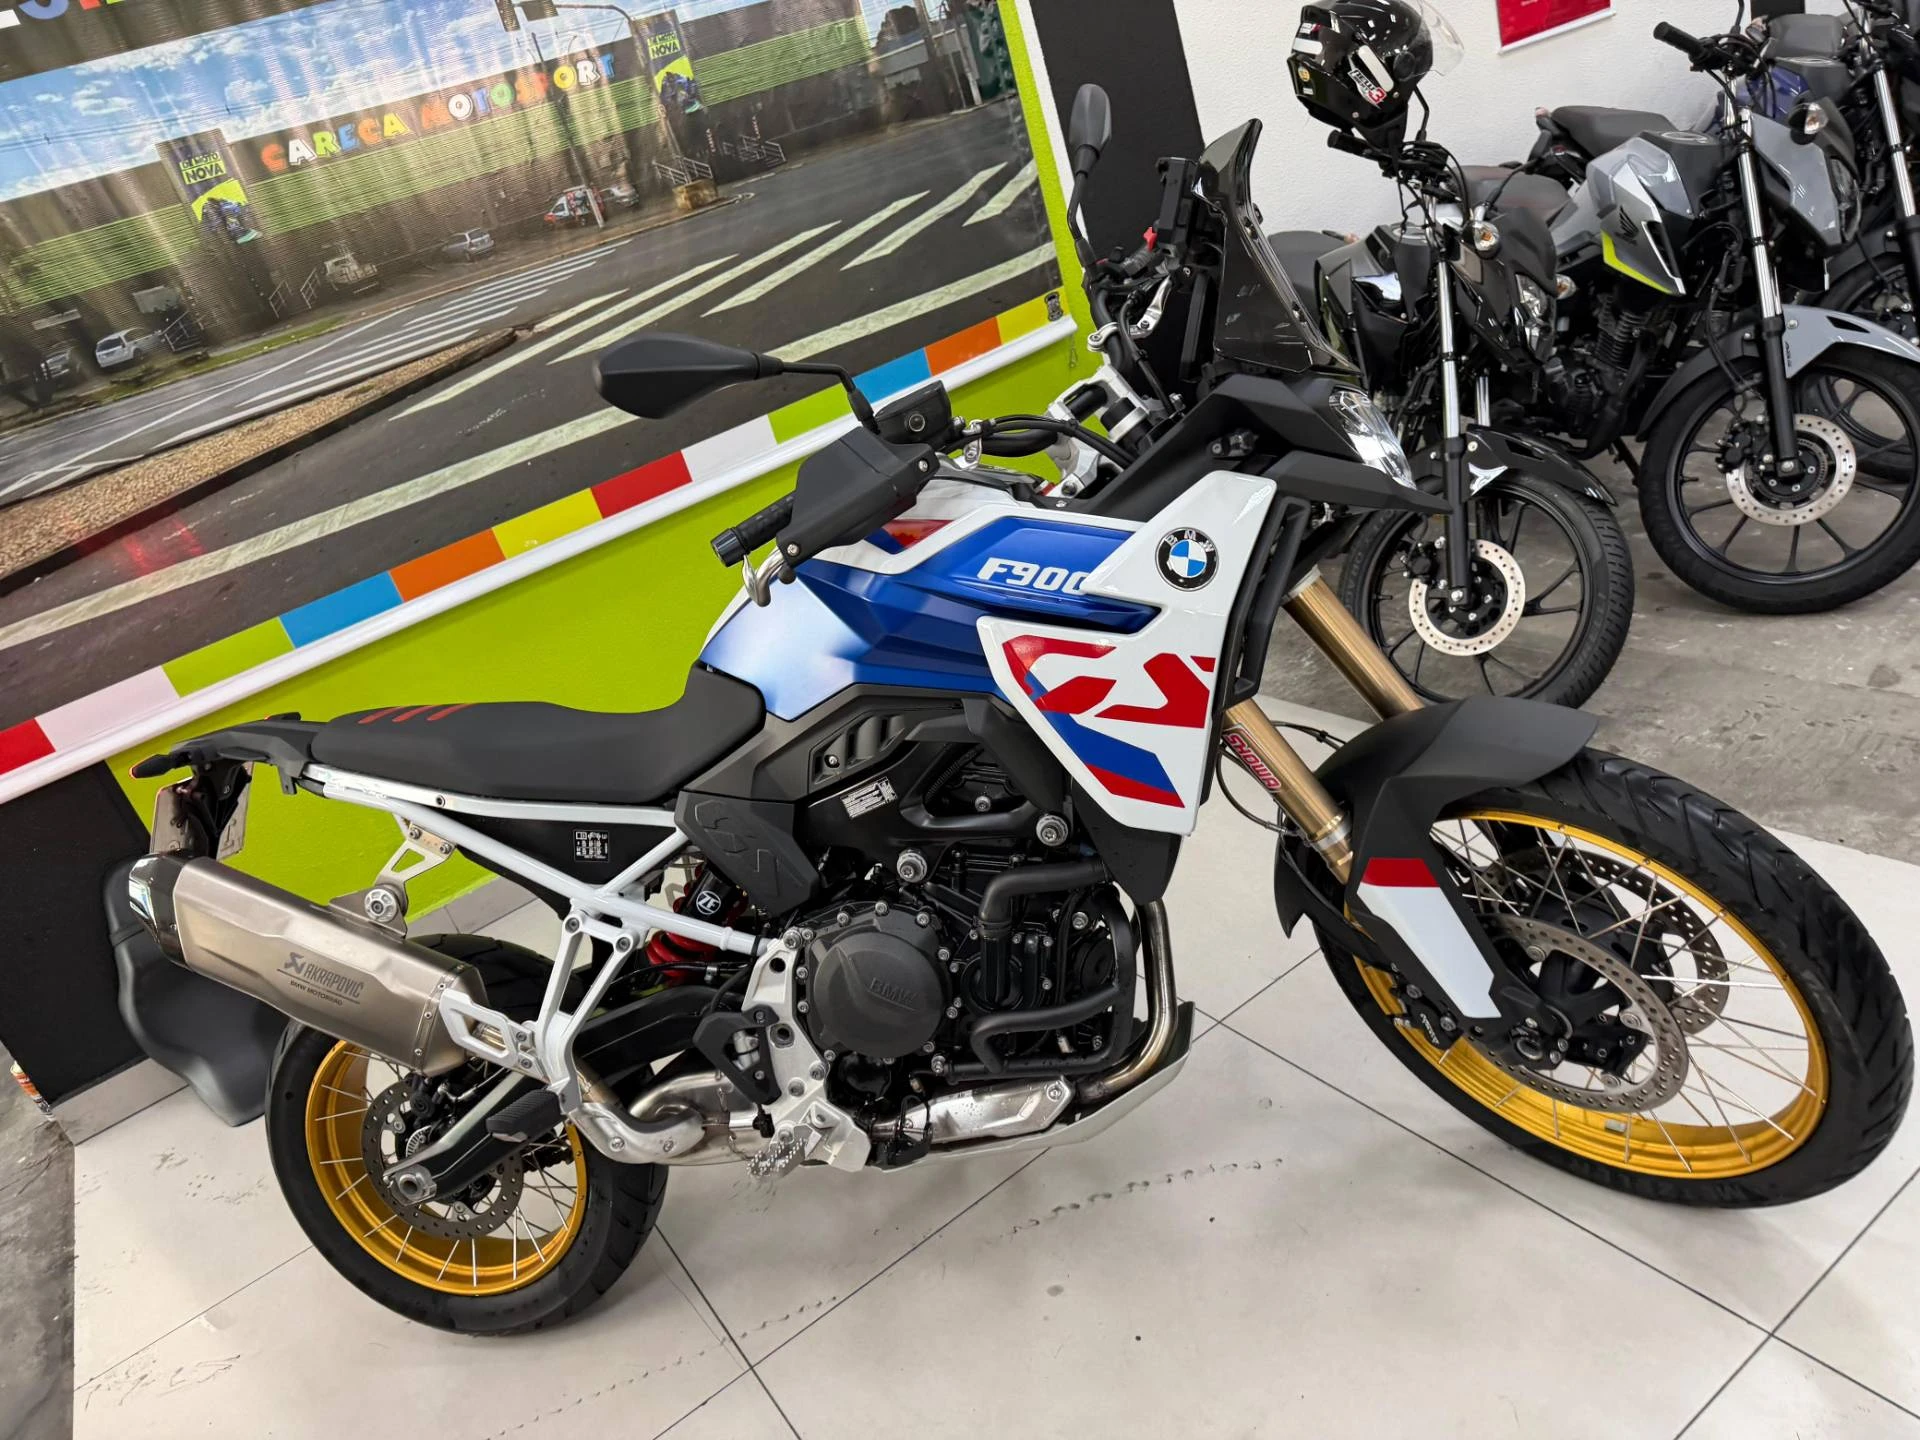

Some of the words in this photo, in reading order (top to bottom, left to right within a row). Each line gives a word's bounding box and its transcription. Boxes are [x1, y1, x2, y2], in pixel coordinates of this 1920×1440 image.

[651, 41, 679, 57] NOVA
[261, 112, 413, 174] CARECA
[185, 163, 224, 183] NOVA
[1164, 529, 1216, 552] BMW
[1002, 635, 1216, 729] GS
[1223, 733, 1281, 789] SHOWA
[697, 891, 721, 914] ZF
